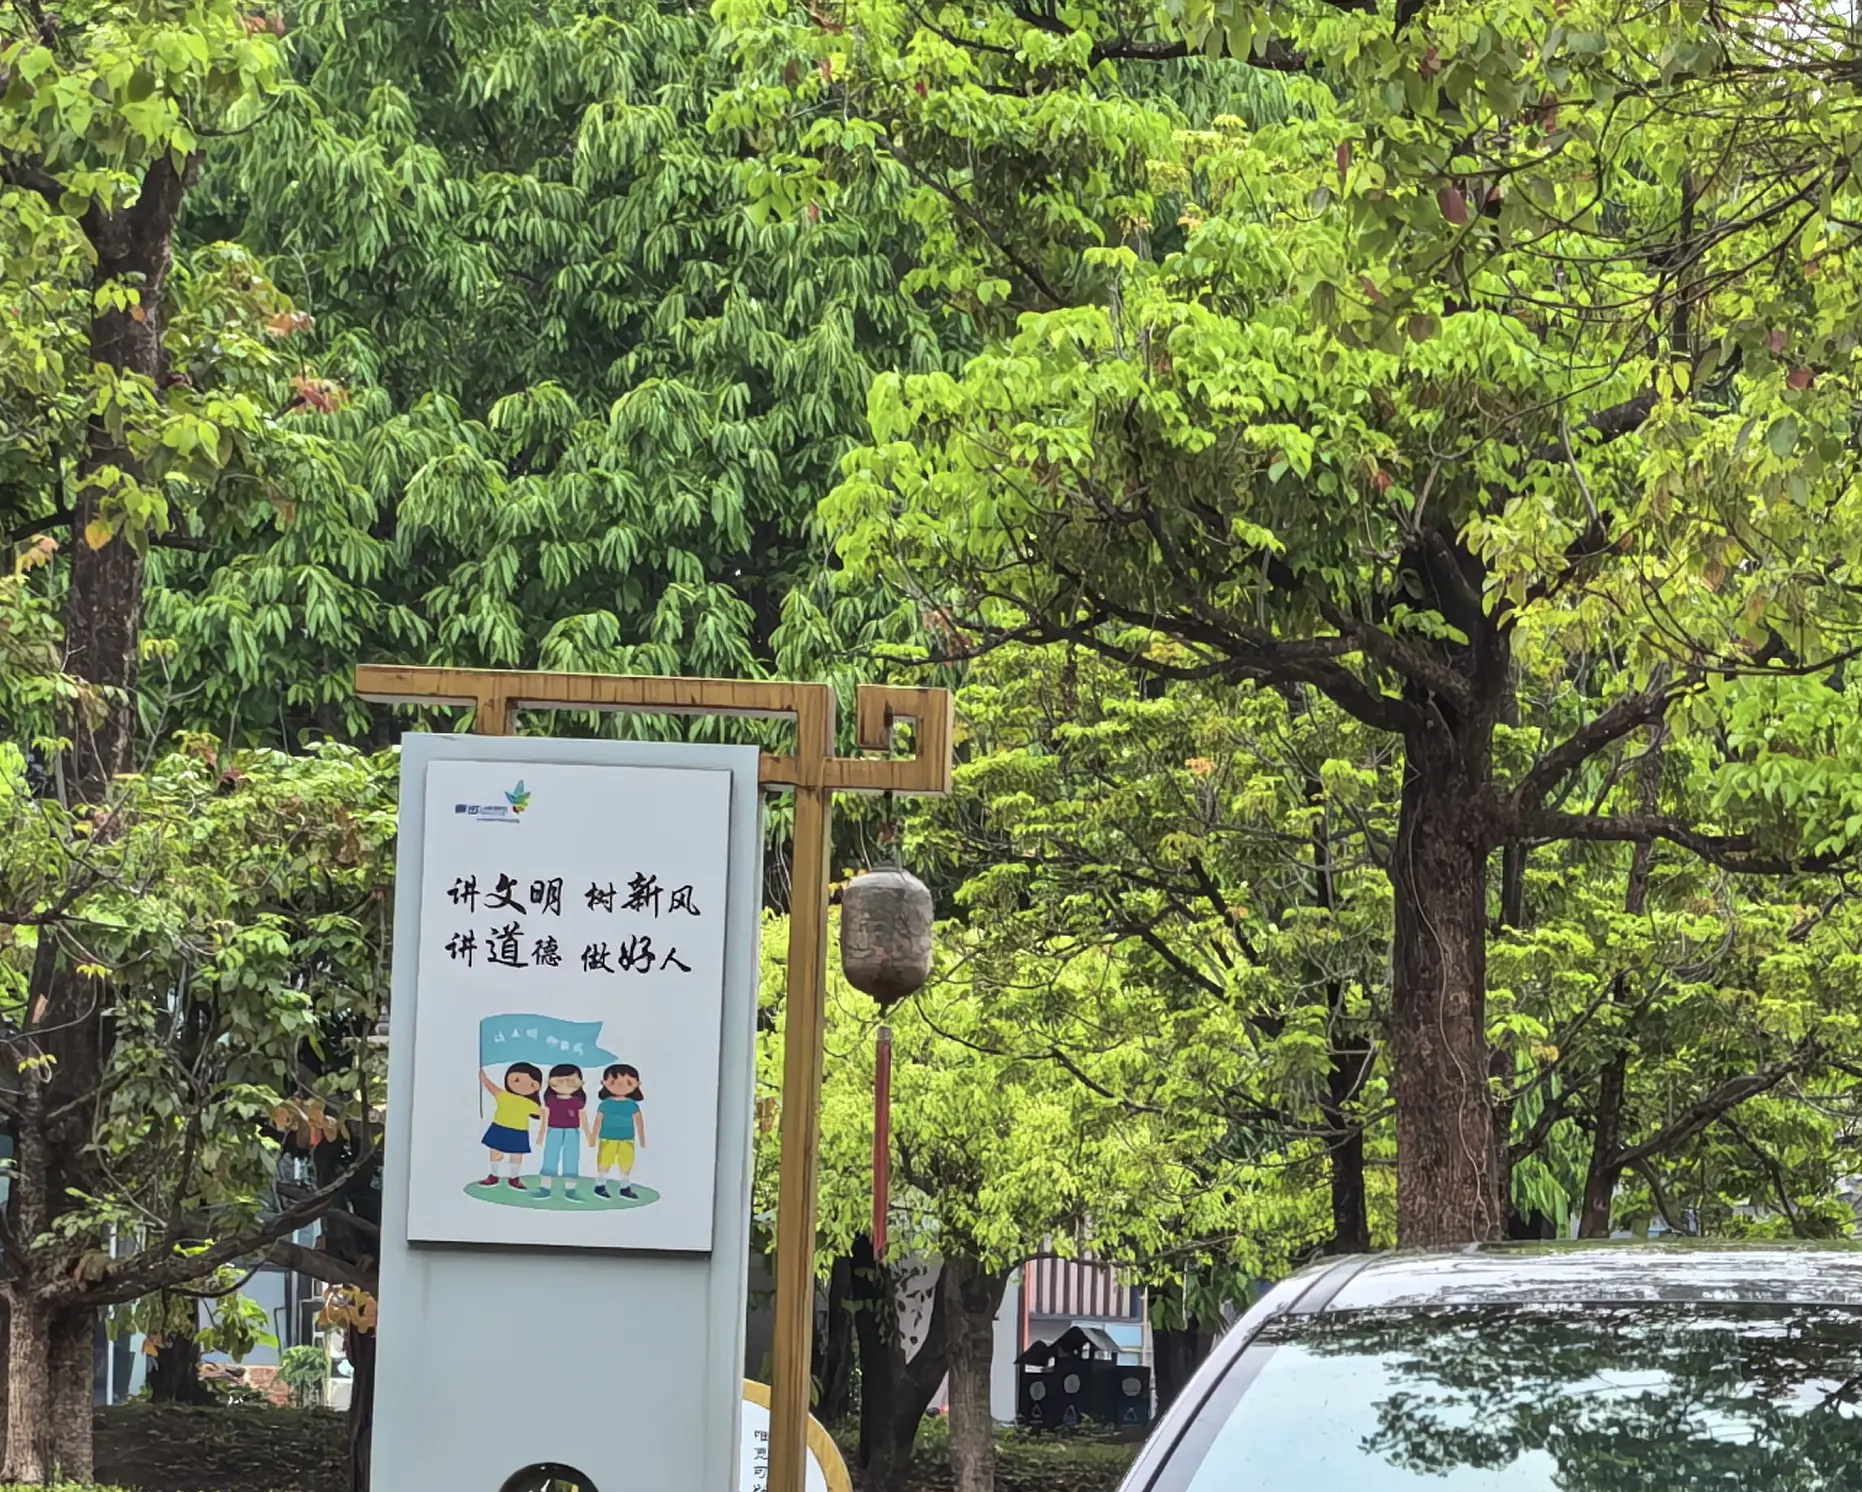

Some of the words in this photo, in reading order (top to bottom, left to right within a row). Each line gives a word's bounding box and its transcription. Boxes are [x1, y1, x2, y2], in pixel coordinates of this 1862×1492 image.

[447, 873, 563, 916] 讲文明
[584, 872, 701, 918] 树新风
[445, 921, 562, 968] 讲道德
[581, 935, 692, 974] 做好人
